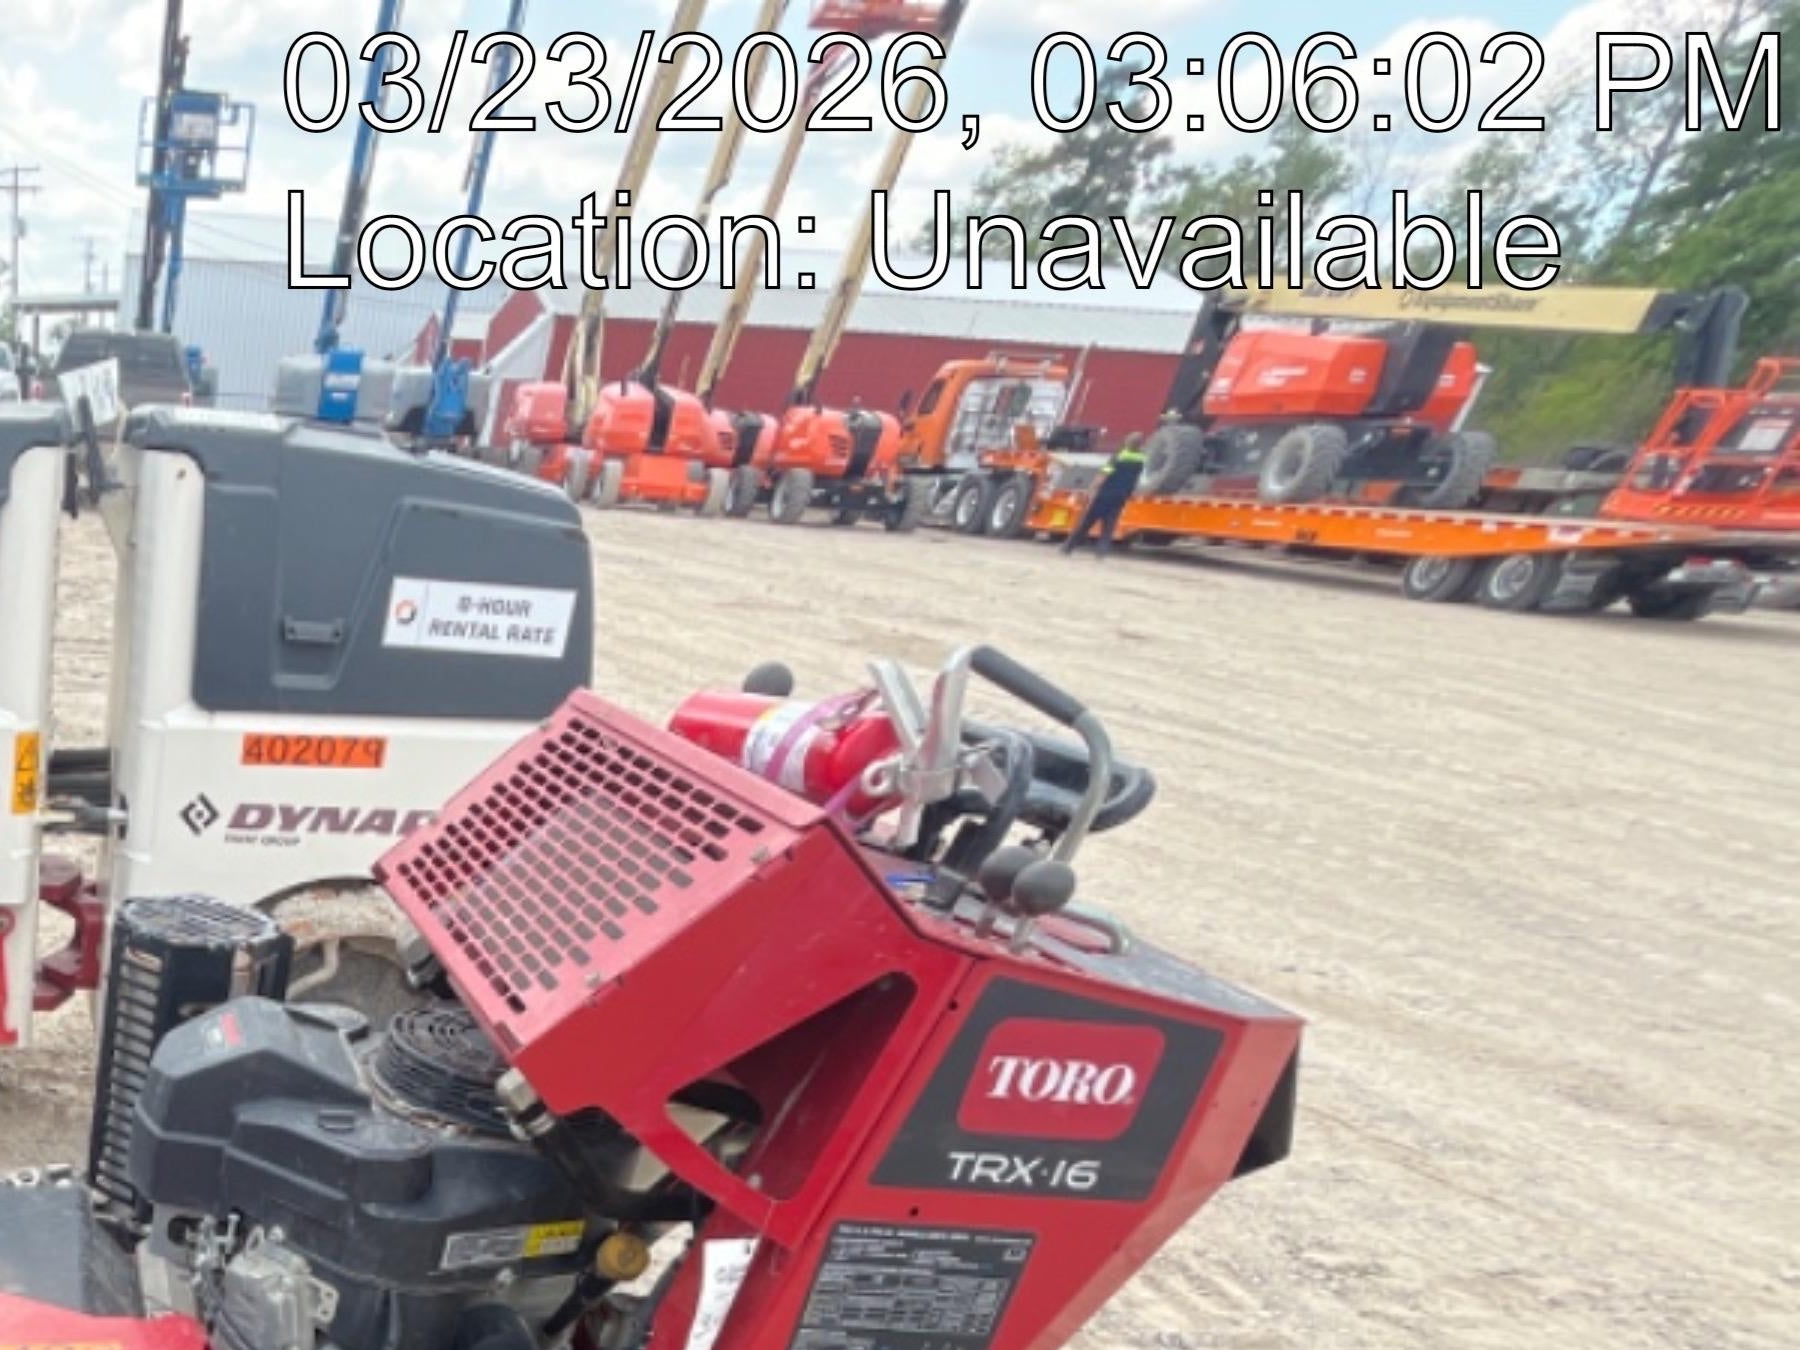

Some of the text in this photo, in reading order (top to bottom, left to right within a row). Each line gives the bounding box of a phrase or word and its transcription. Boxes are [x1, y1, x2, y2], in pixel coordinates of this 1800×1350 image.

[428, 617, 557, 645] RENTAL RATE
[243, 734, 386, 768] 402079
[986, 1055, 1136, 1105] TORO
